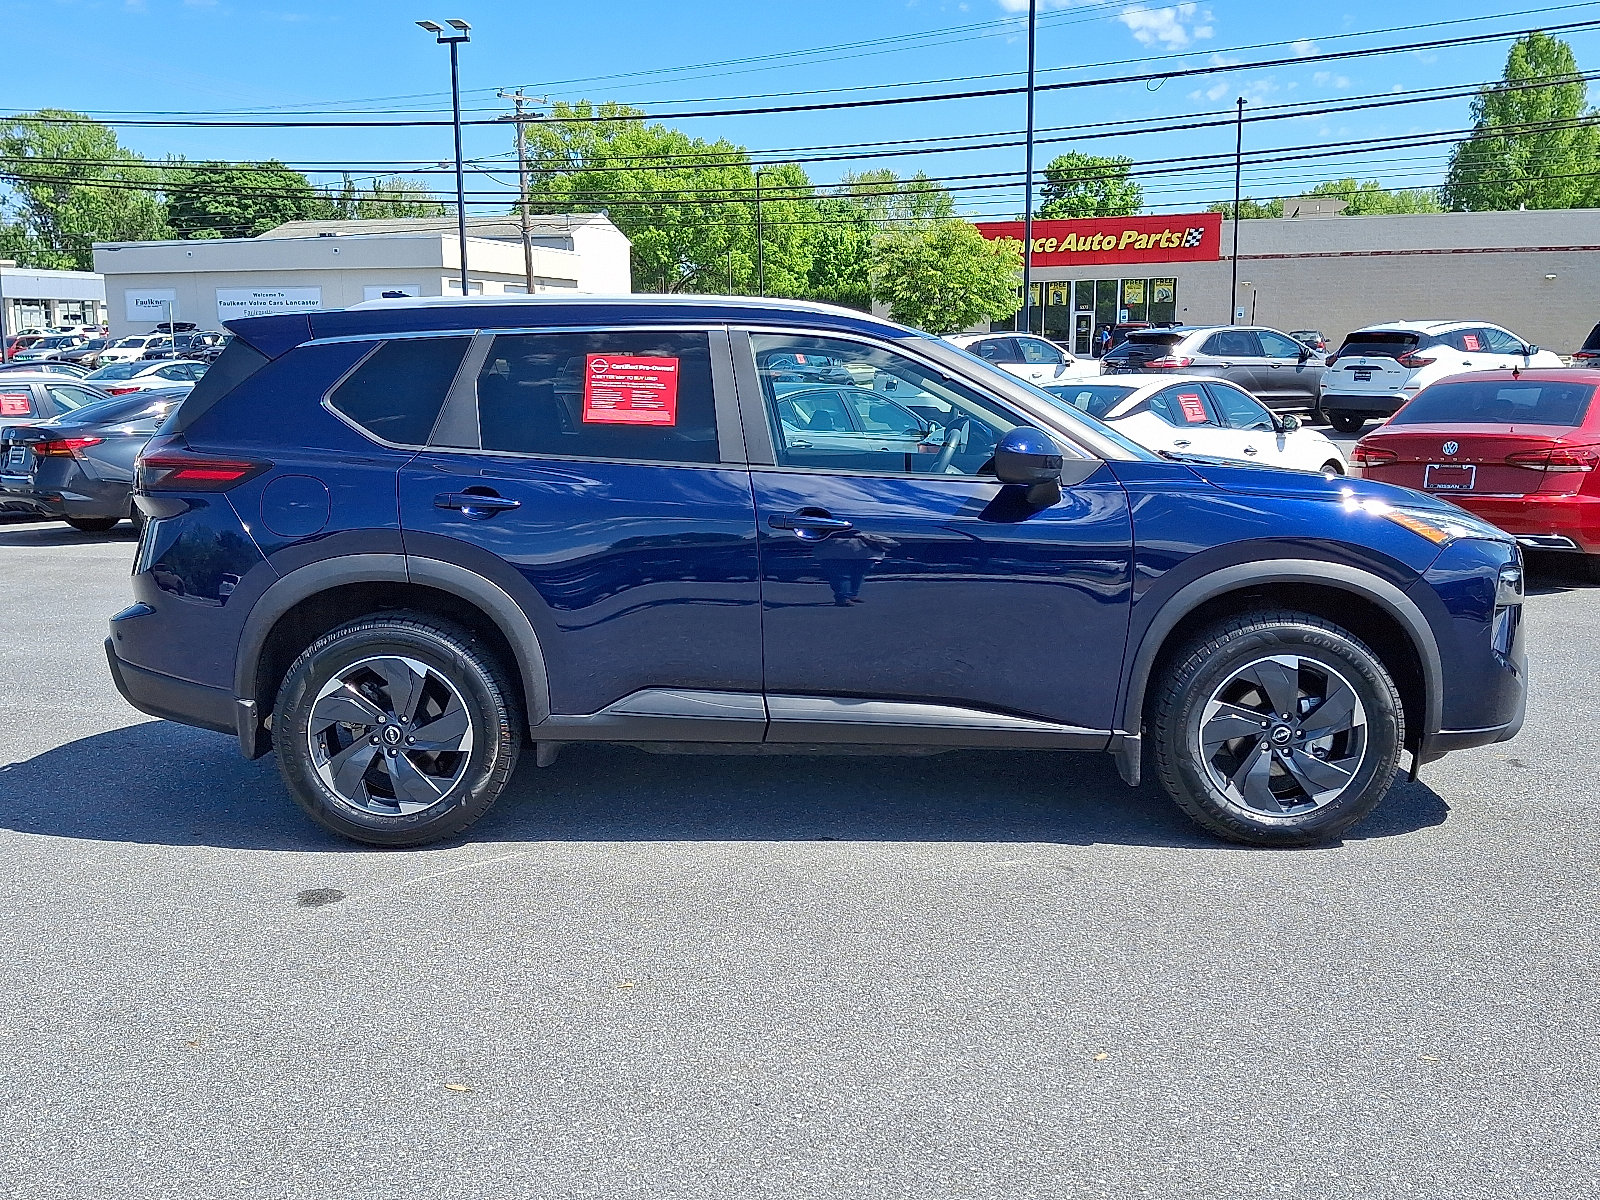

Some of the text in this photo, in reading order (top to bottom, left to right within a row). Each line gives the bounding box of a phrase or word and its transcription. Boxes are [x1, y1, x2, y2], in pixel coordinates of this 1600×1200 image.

[1059, 231, 1117, 252] Auto
[1118, 228, 1182, 250] Parts
[135, 298, 164, 306] Faulkn
